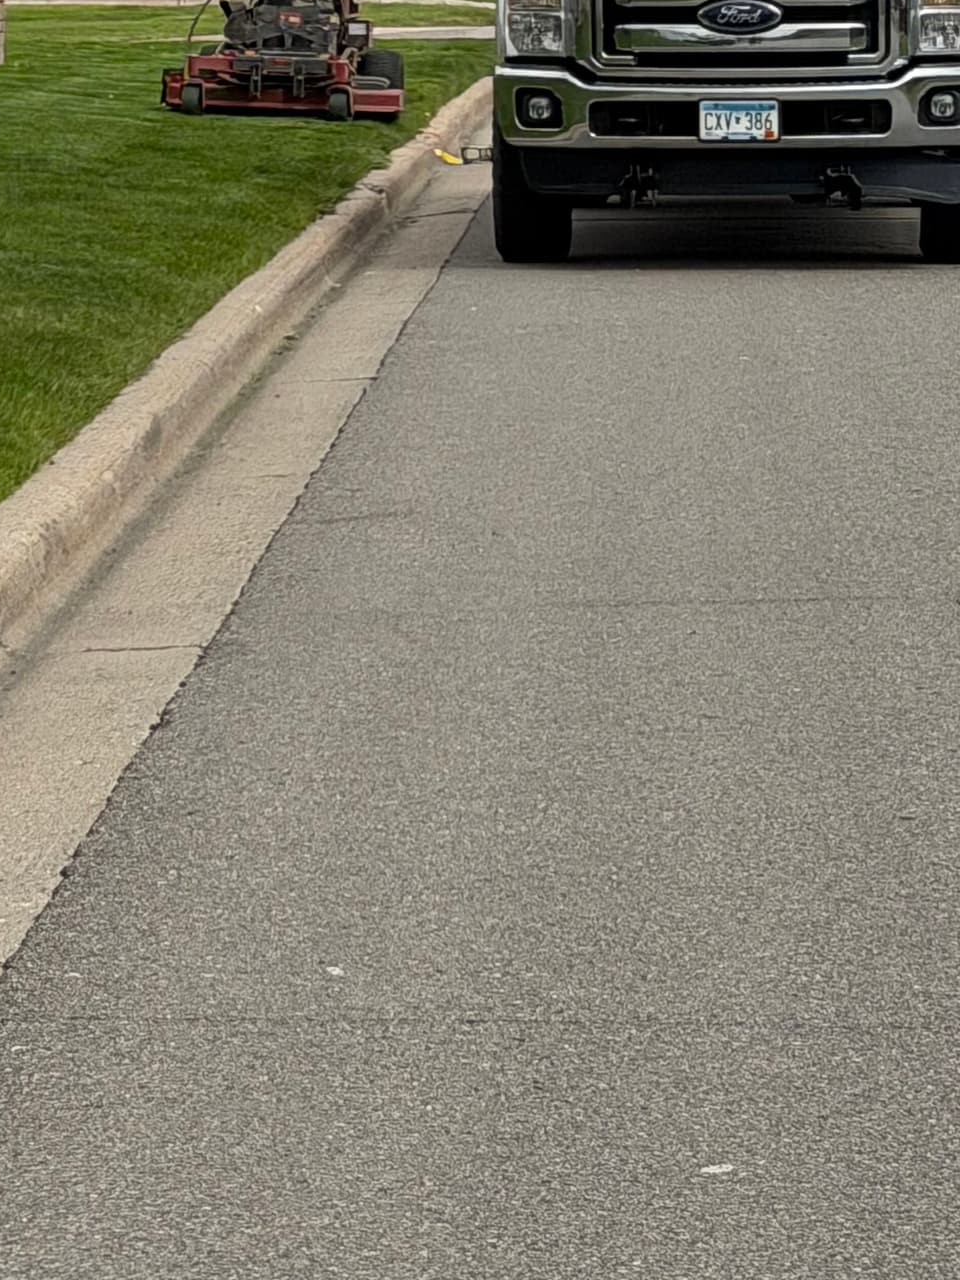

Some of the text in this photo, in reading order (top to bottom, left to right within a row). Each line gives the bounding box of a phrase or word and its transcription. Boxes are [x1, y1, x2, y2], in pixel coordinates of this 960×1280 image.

[716, 4, 762, 24] Ford
[704, 111, 773, 131] CXV 386
